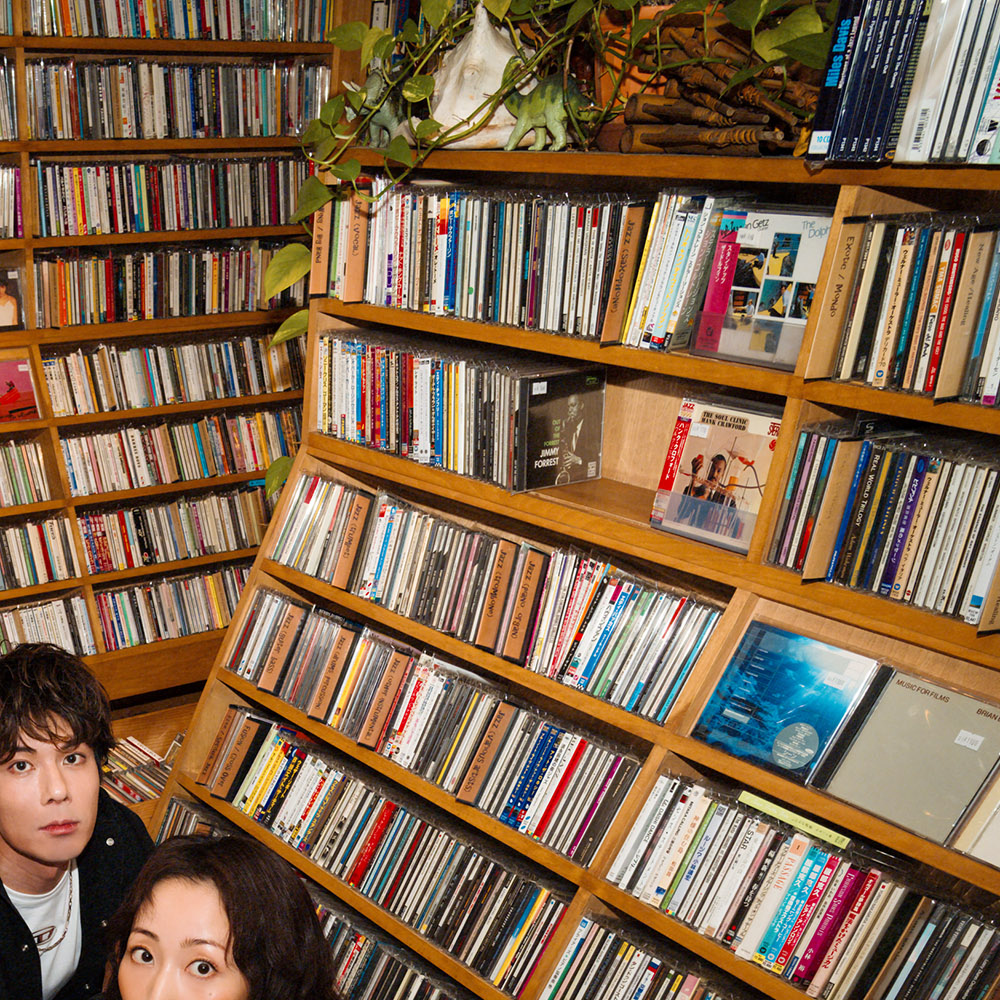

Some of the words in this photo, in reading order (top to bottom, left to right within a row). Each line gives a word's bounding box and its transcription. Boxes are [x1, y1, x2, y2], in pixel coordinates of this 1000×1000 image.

[833, 19, 852, 53] Davis
[825, 55, 844, 87] Miles
[802, 221, 816, 230] The
[682, 402, 695, 410] JAZZ
[714, 413, 728, 421] SOUL
[729, 416, 748, 424] CLINIC
[716, 420, 746, 431] CRAWFORD
[540, 447, 560, 457] JIMMY
[534, 457, 559, 469] FORREST
[871, 454, 880, 472] REAL
[863, 474, 873, 494] WORLD
[855, 495, 868, 526] TRILOGY
[896, 679, 917, 692] MUSIC
[916, 686, 930, 695] FOR
[929, 692, 950, 703] FILMS
[494, 711, 505, 730] Jazz
[976, 708, 997, 721] BRIAN
[740, 830, 755, 850] STAR
[773, 857, 796, 889] PASSAGE
